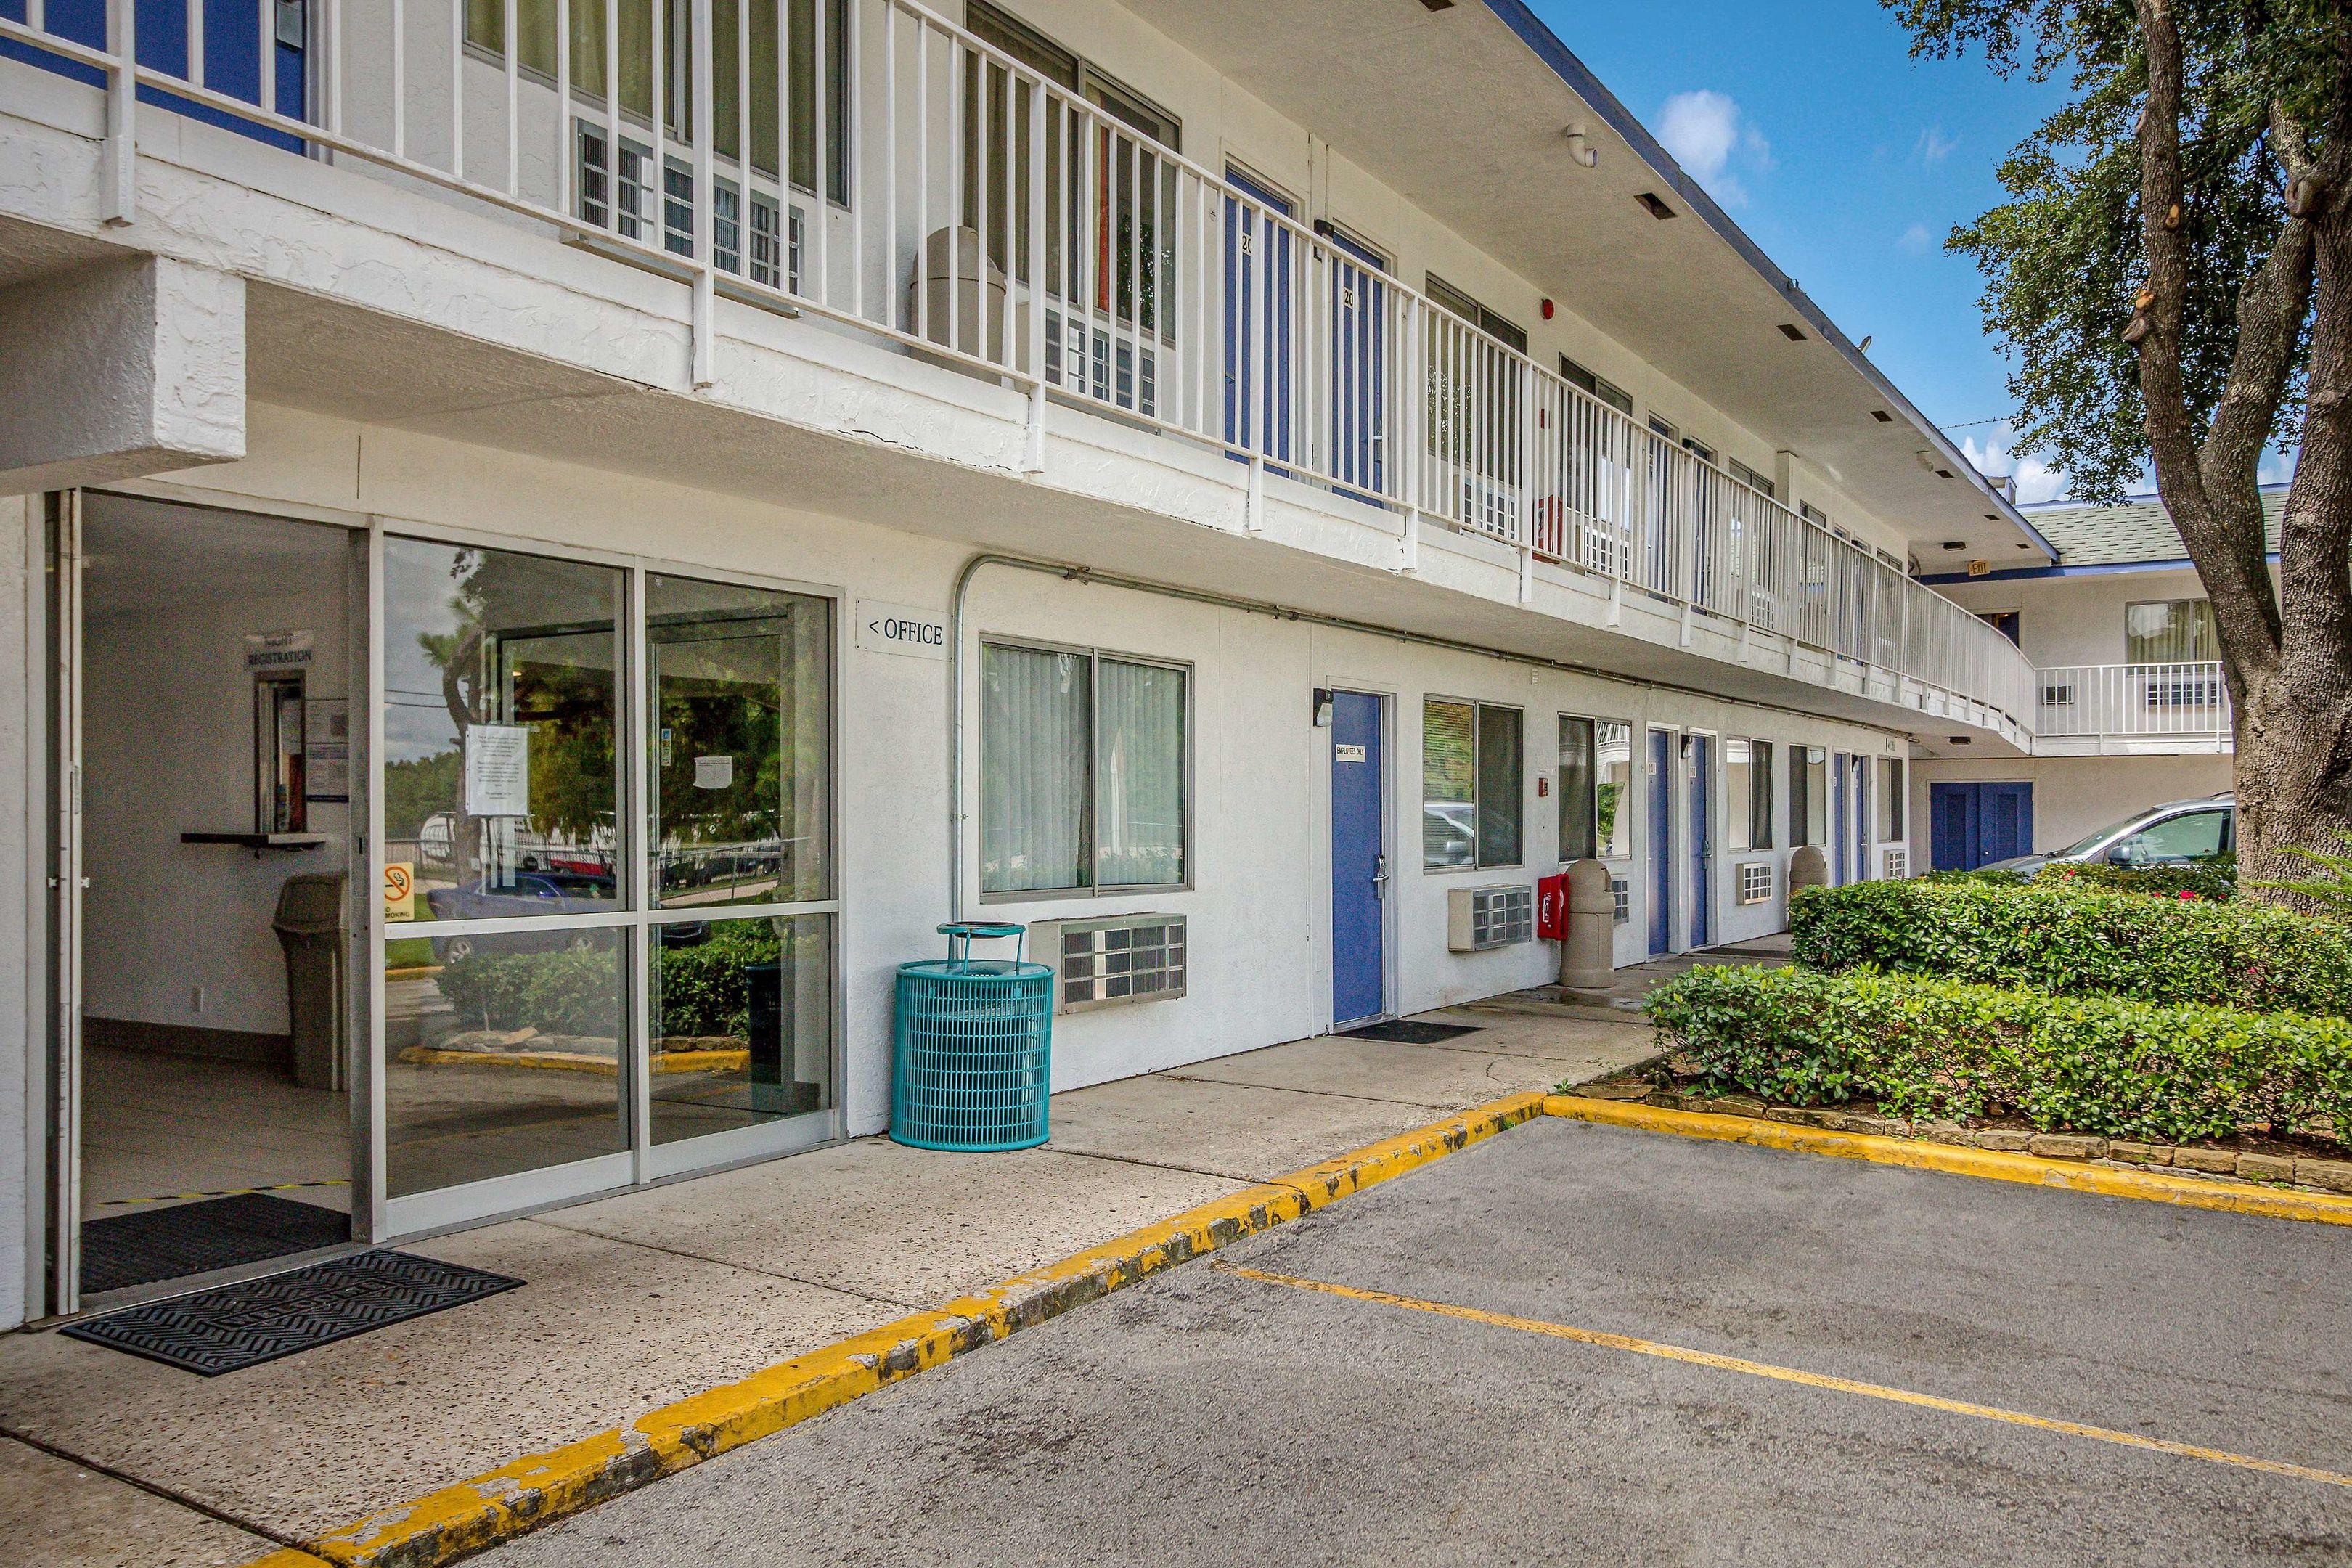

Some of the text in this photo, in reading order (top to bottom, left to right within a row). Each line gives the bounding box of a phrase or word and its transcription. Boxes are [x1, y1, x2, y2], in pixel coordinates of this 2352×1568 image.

[1242, 235, 1251, 253] 20
[1344, 290, 1353, 306] 20
[1972, 562, 1986, 574] EXIT
[884, 618, 942, 645] OFFICE
[248, 650, 311, 666] REGISTRATION
[220, 1280, 387, 1325] WELCOME
